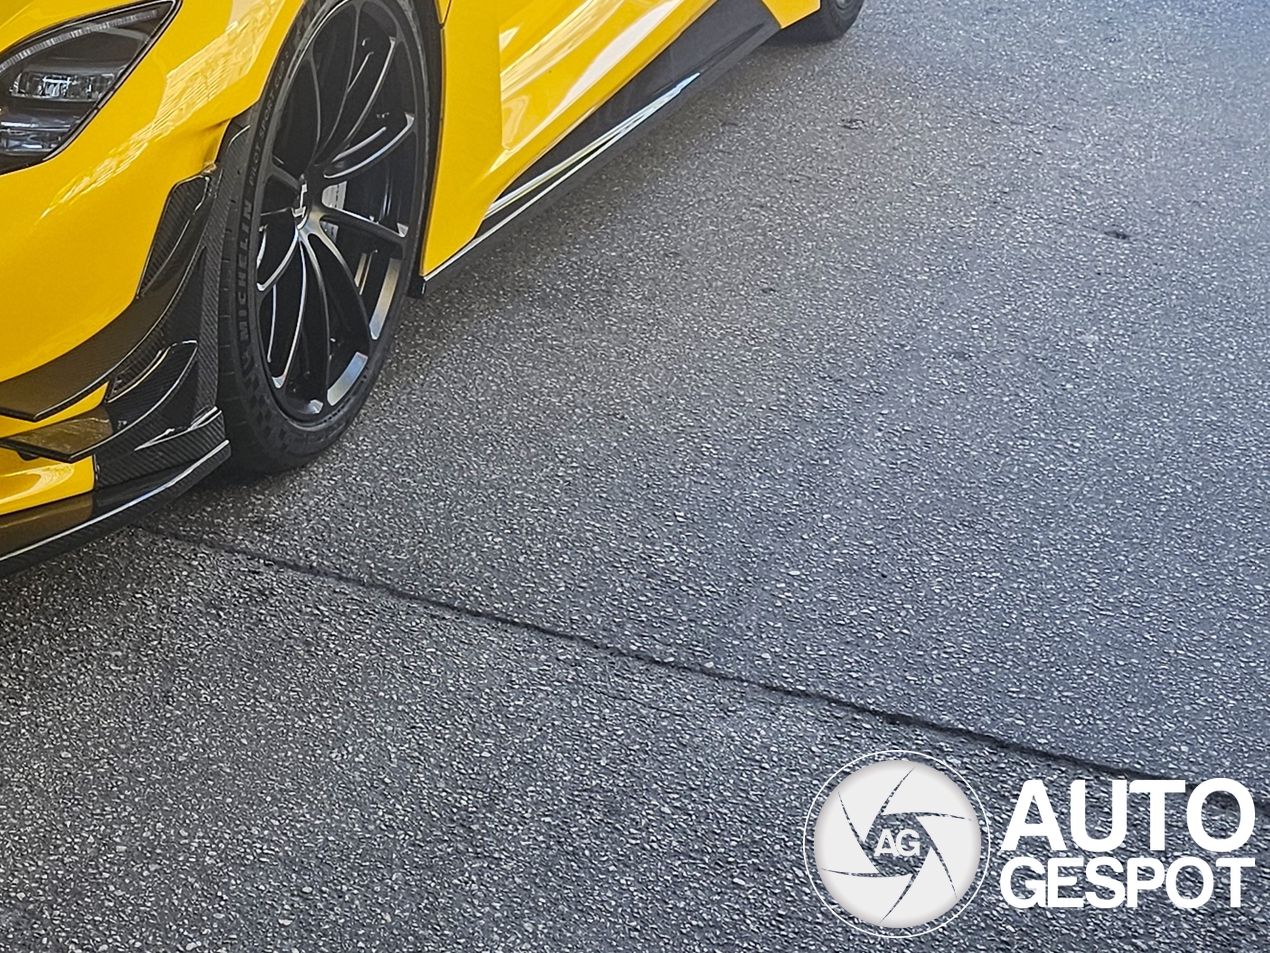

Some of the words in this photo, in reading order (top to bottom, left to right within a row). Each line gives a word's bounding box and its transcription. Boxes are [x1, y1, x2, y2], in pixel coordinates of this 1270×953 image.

[238, 200, 252, 341] MICHELIN
[249, 144, 261, 186] PILOT
[260, 90, 275, 139] SPORT
[275, 60, 286, 88] CUP
